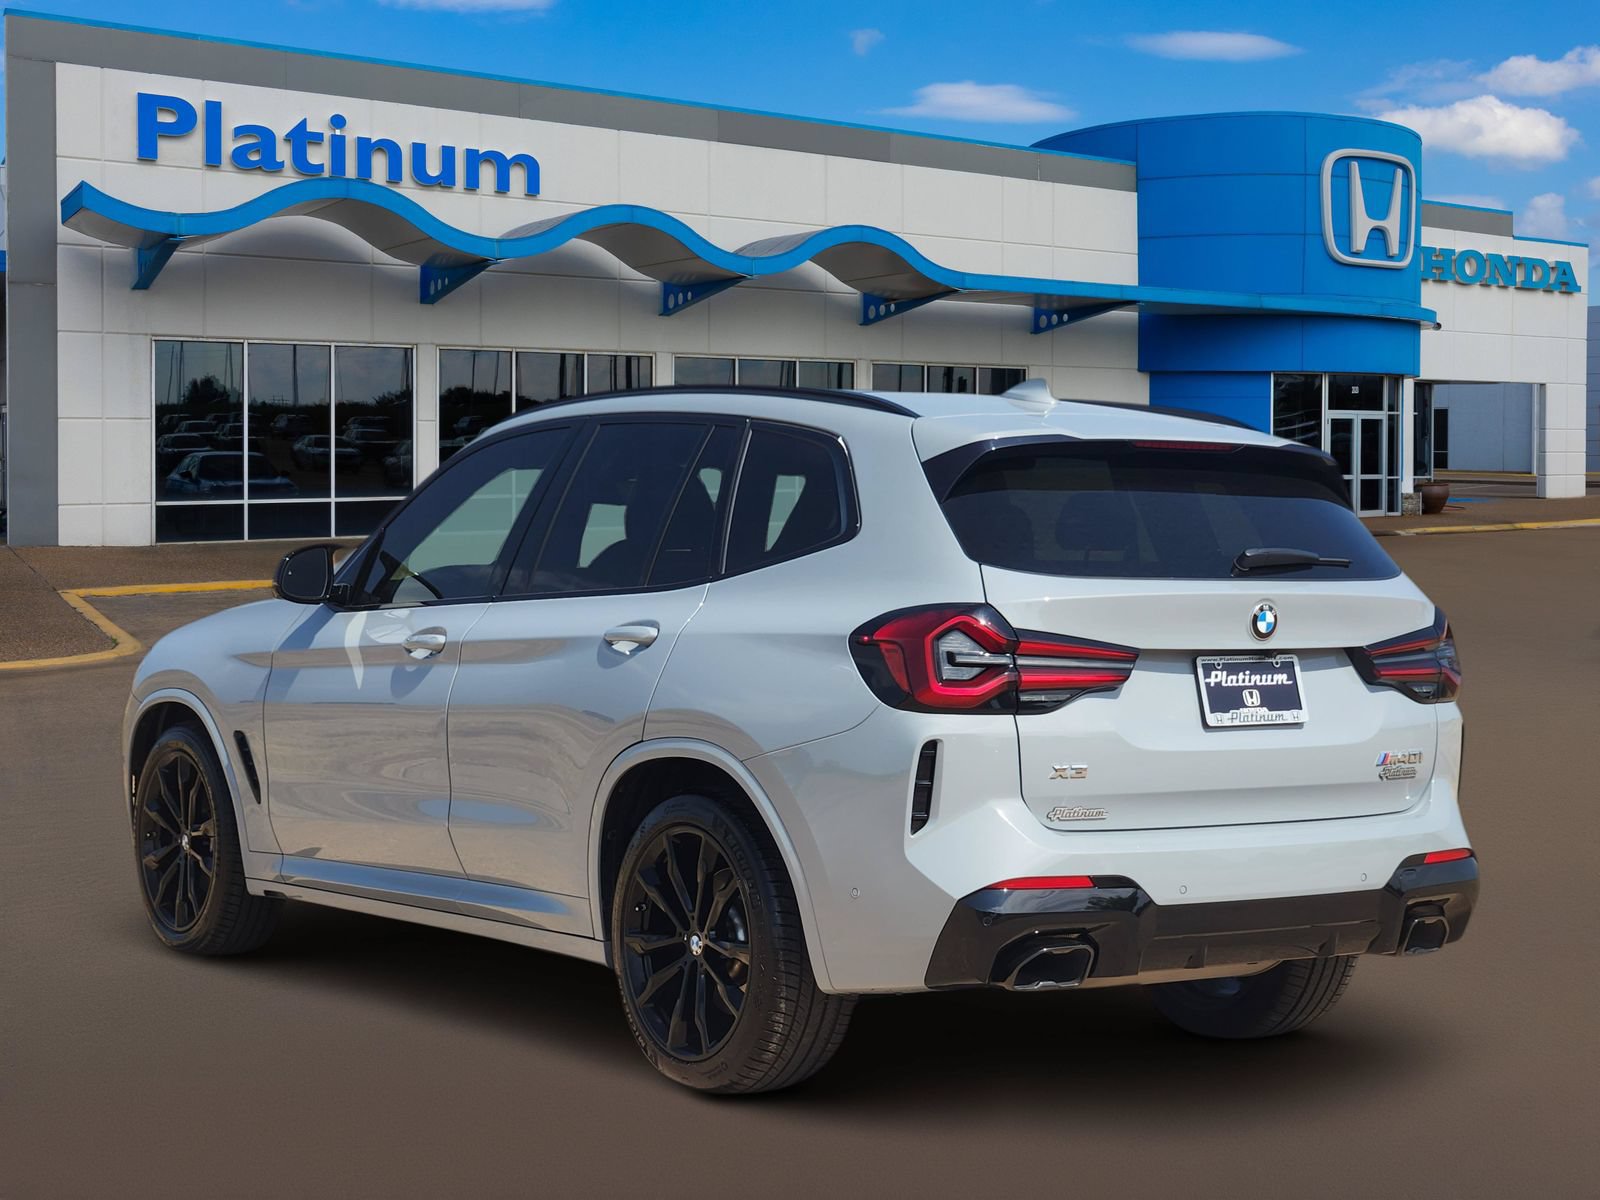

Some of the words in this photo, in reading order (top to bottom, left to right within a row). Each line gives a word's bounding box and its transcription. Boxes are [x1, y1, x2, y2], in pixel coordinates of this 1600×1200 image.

[137, 92, 541, 197] Platinum
[1421, 246, 1581, 294] HONDA
[1205, 670, 1293, 687] Platinum
[1228, 711, 1288, 724] Platinum
[1048, 764, 1089, 780] X3
[1047, 805, 1109, 821] Platinum
